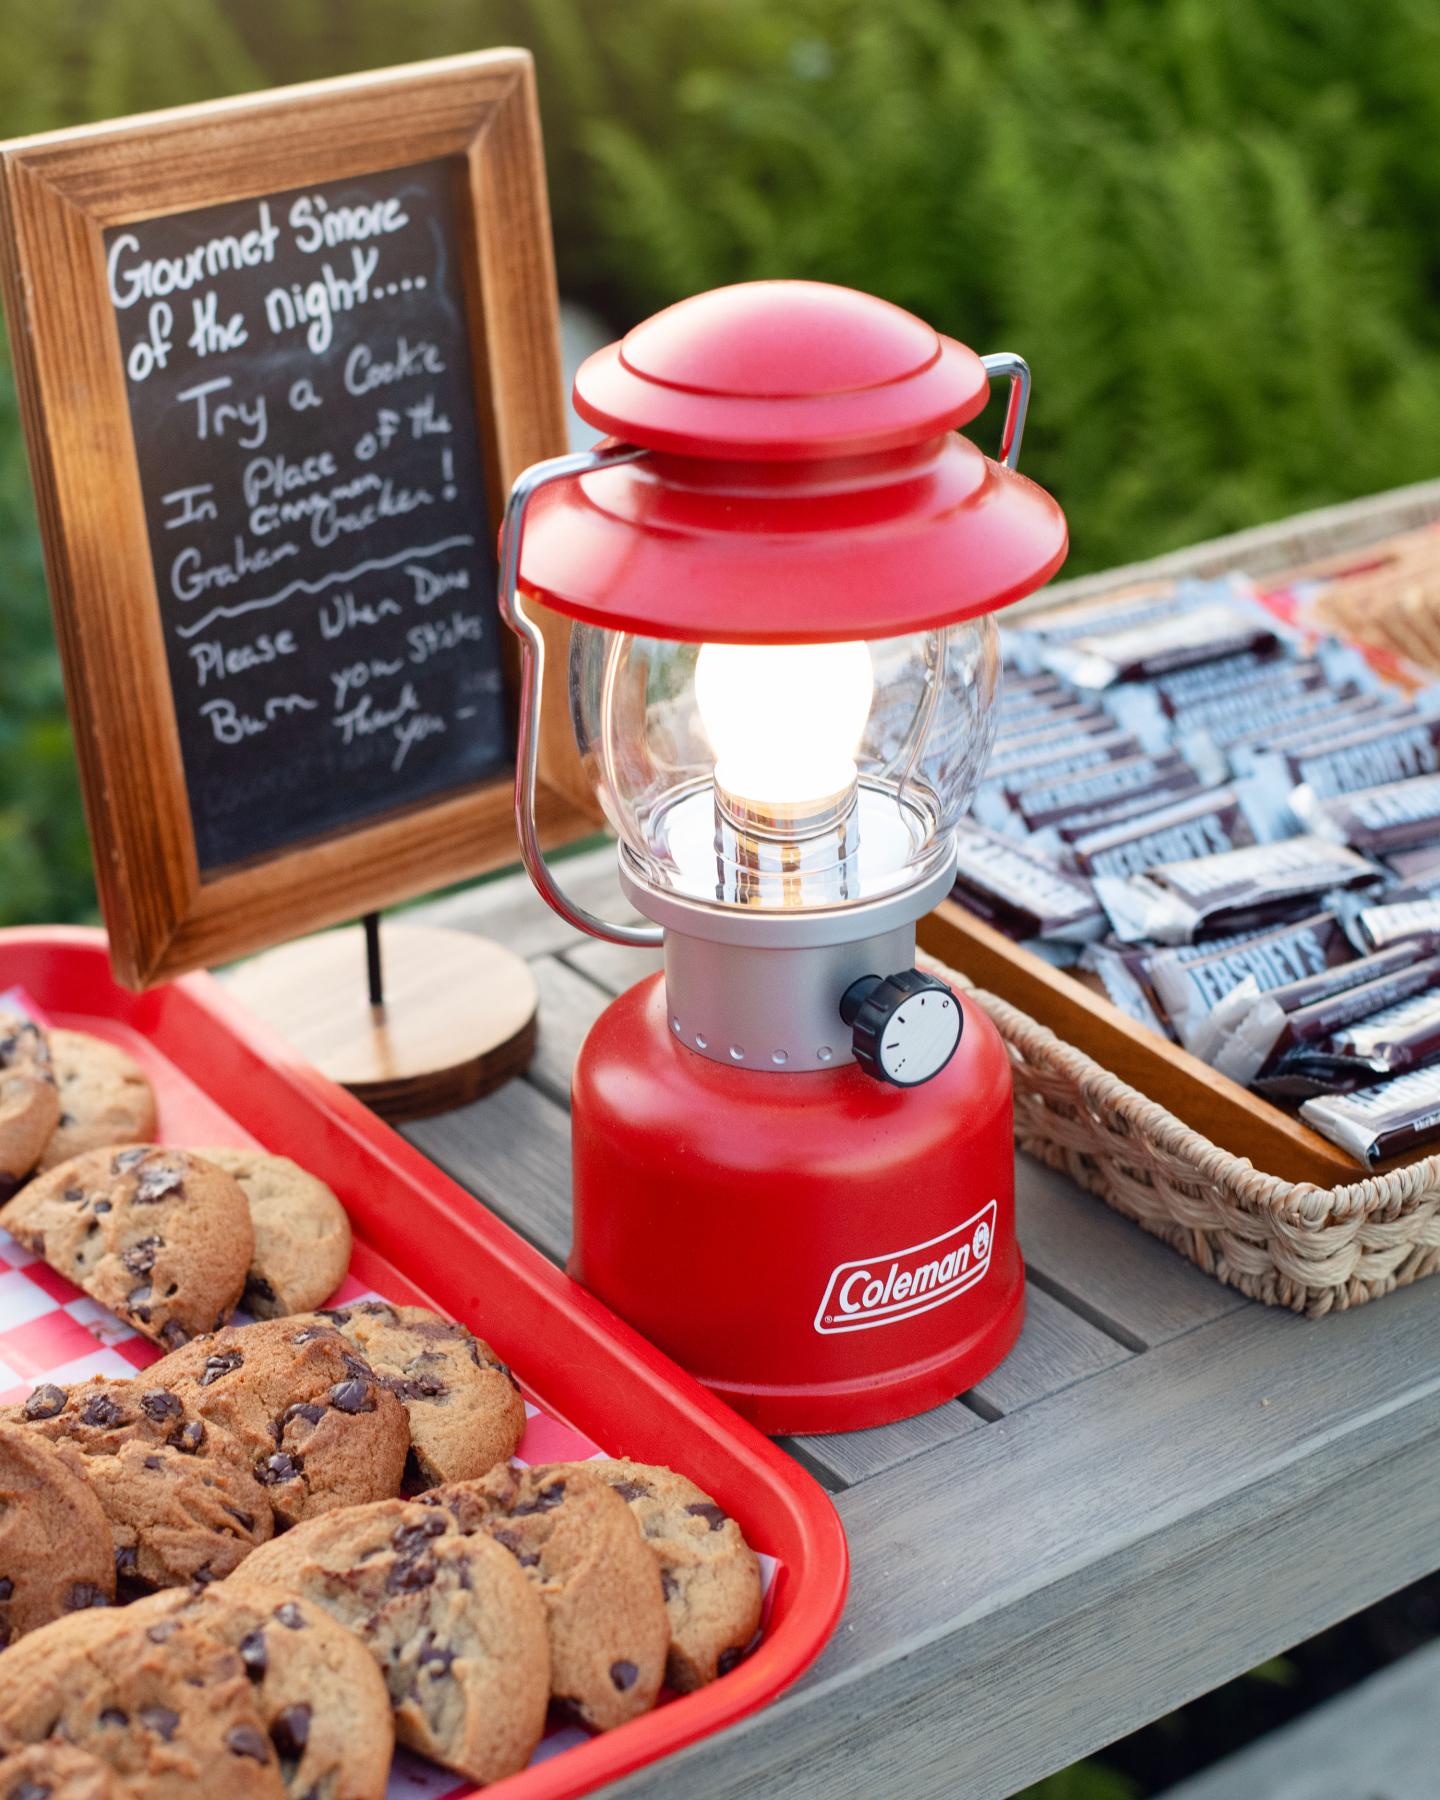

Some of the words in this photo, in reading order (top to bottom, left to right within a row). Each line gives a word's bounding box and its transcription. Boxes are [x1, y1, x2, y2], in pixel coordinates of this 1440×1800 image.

[107, 201, 280, 308] Gourmet
[128, 302, 173, 382] of
[188, 291, 249, 357] the
[177, 376, 268, 449] Try
[289, 379, 323, 412] a
[344, 335, 447, 396] Cookie
[162, 484, 217, 530] In
[243, 452, 337, 508] Place
[354, 408, 400, 460] of
[171, 535, 299, 601] Graham
[188, 629, 298, 688] Please
[403, 564, 469, 606] Done
[199, 694, 318, 745] Burn
[839, 1243, 971, 1314] Coleman
